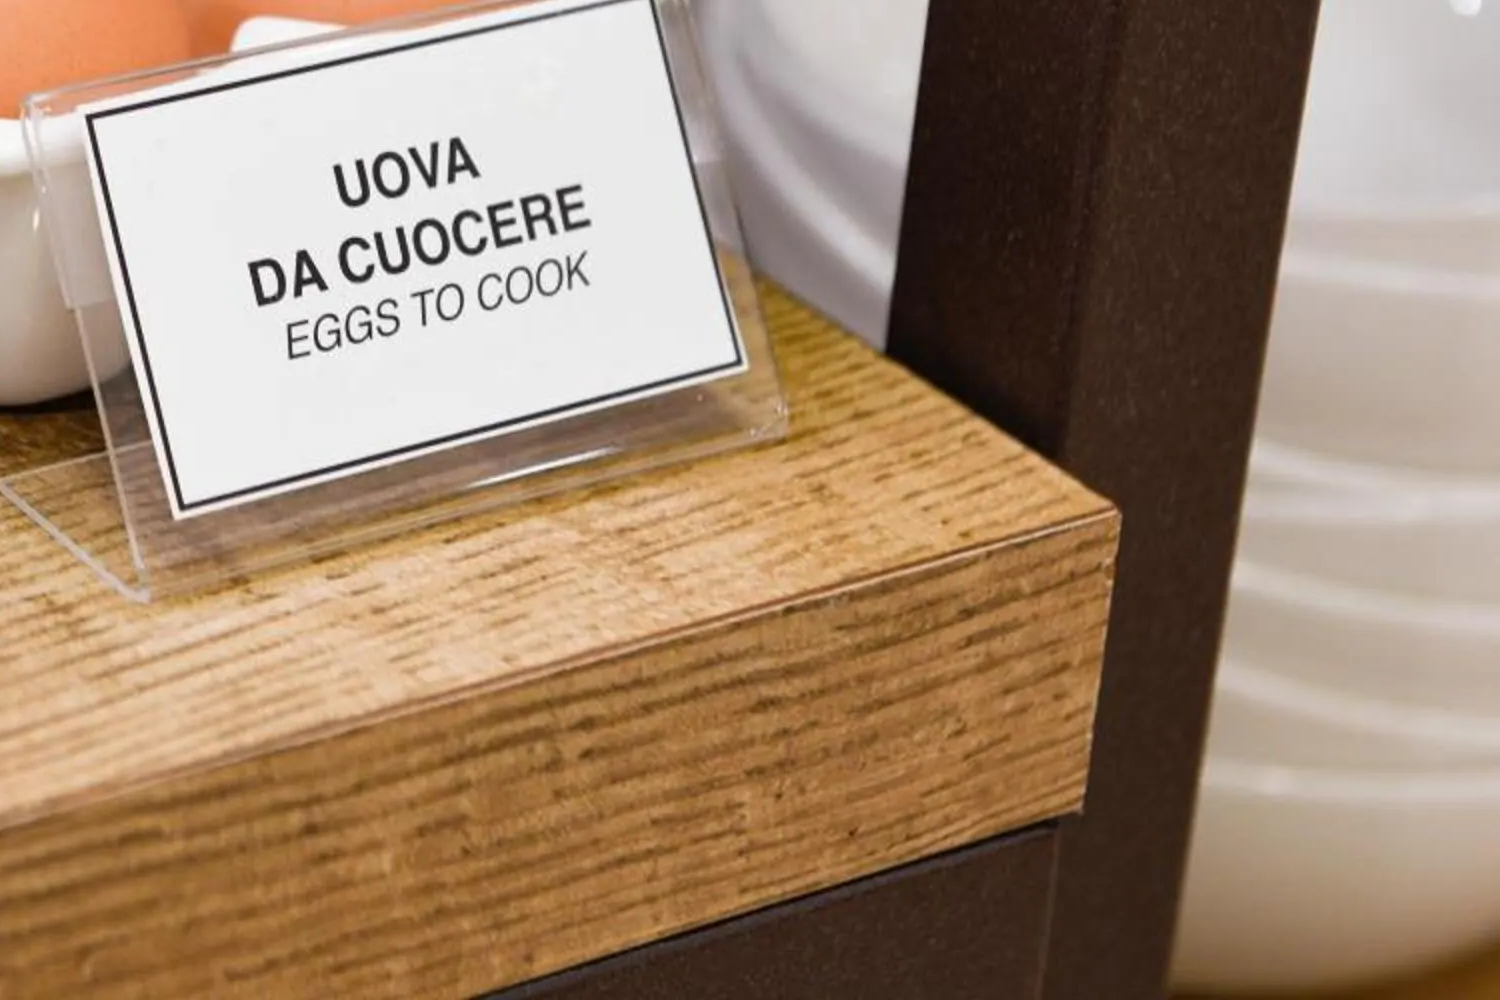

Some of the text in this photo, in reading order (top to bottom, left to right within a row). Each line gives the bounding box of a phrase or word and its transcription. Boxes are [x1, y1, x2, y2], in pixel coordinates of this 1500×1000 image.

[333, 137, 481, 207] UOVA
[248, 184, 591, 306] DA CUOCERE
[286, 250, 590, 360] EGGS TO COOK
